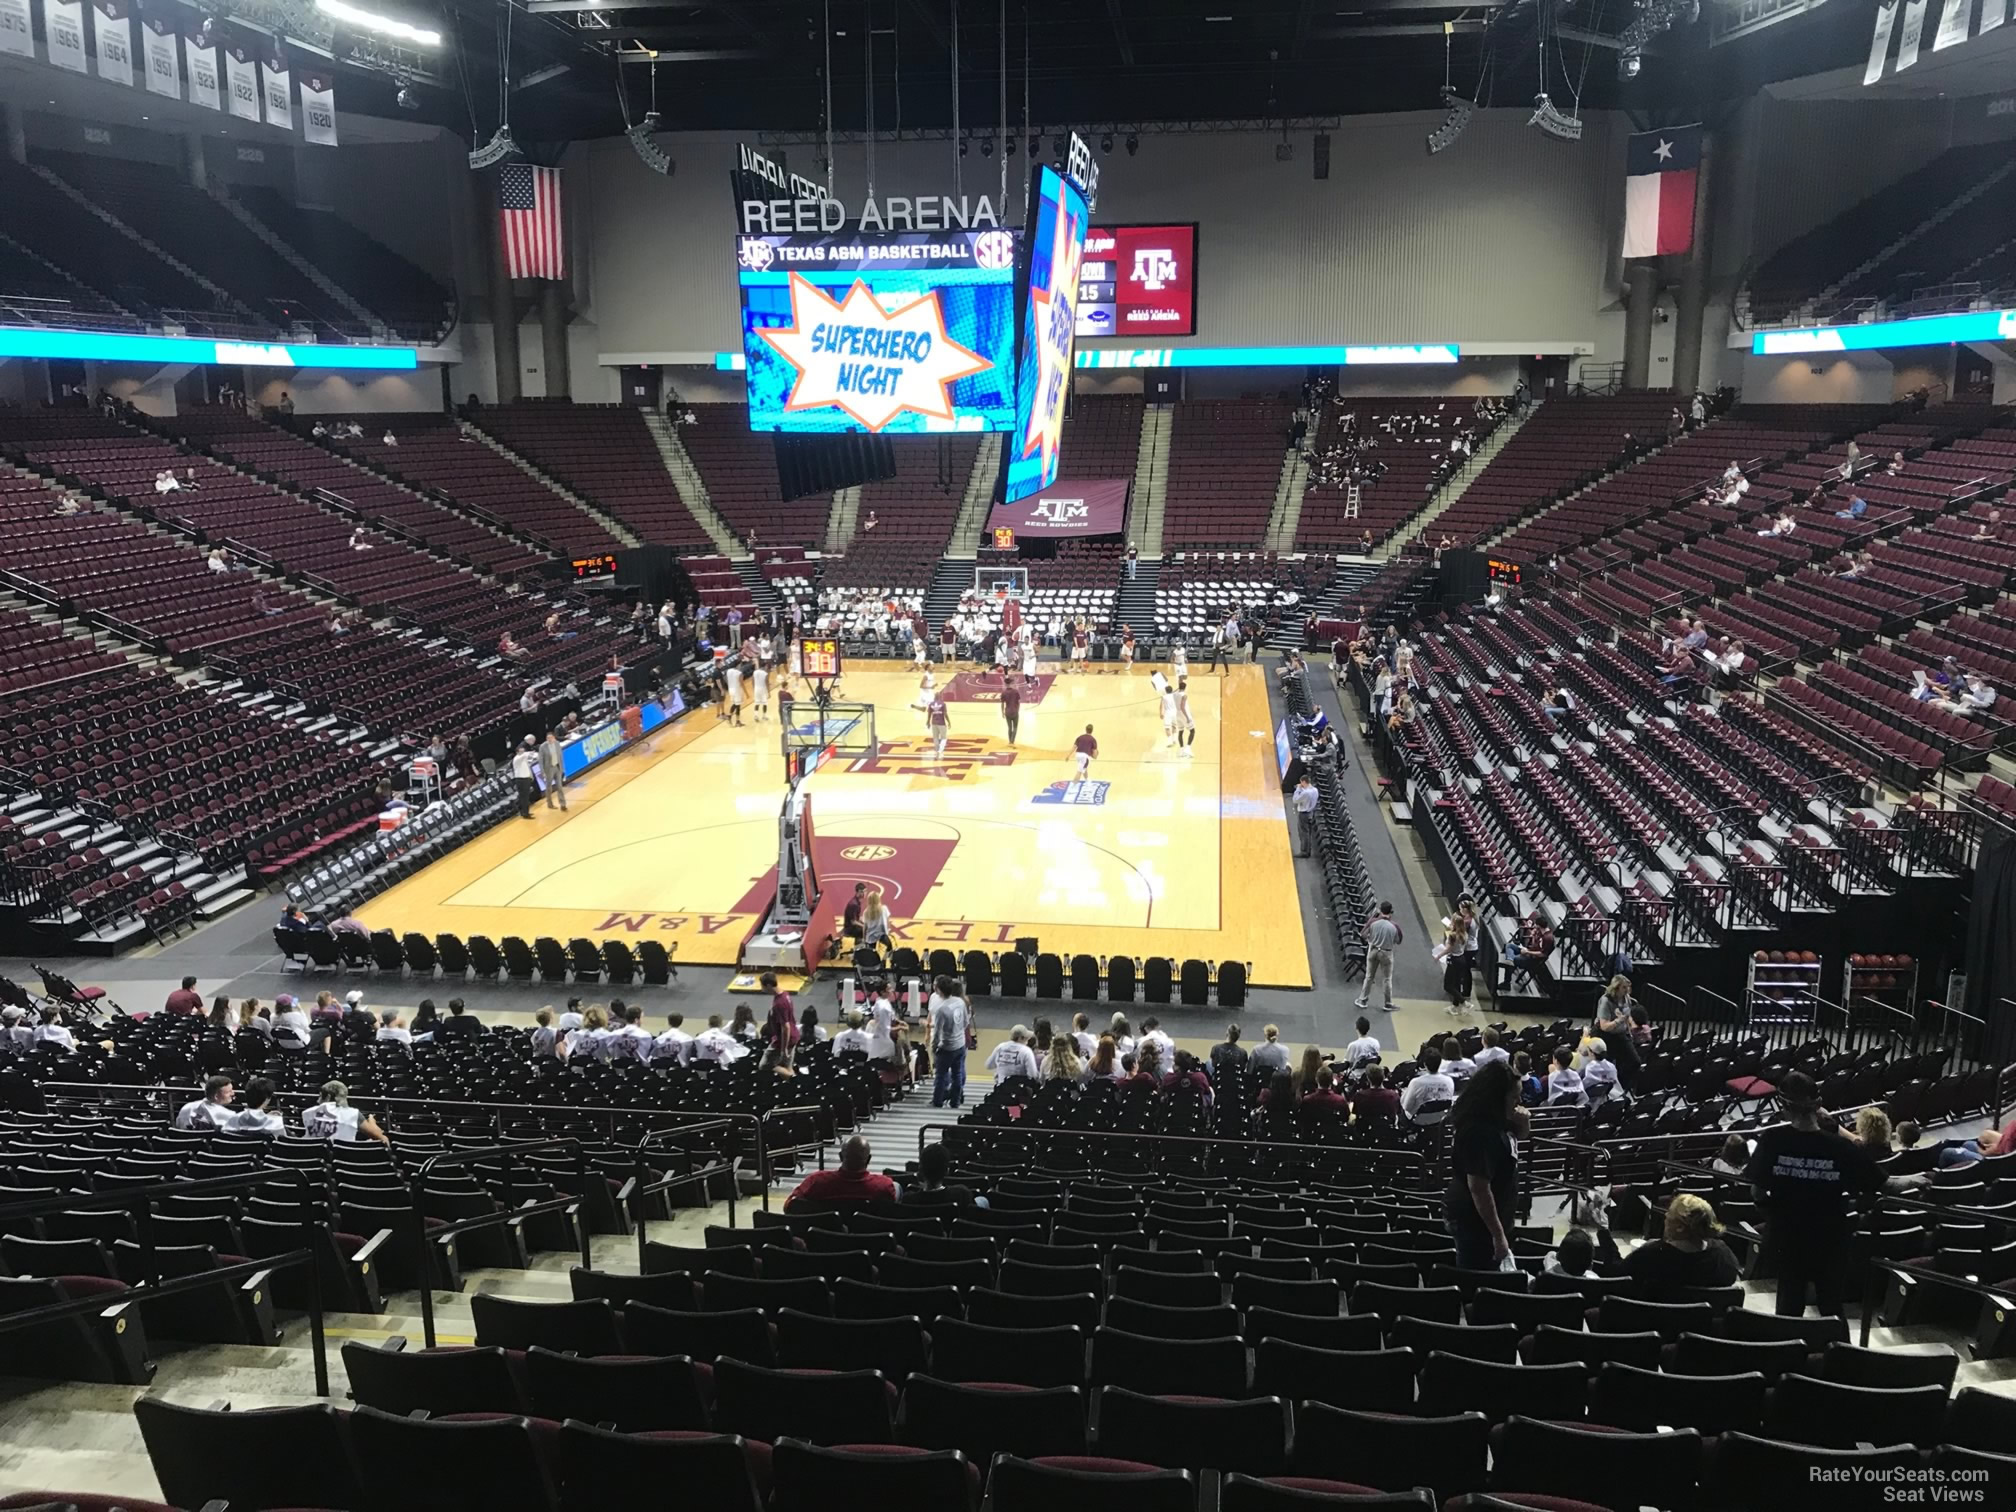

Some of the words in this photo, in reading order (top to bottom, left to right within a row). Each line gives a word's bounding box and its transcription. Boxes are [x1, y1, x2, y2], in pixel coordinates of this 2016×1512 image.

[52, 26, 80, 50] 1969
[102, 41, 128, 64] 1964
[152, 56, 173, 78] 1951
[233, 81, 253, 102] 1922
[269, 92, 287, 111] 1921
[308, 111, 332, 129] 1920
[743, 199, 846, 232] REED
[858, 195, 999, 230] ARENA
[777, 246, 826, 262] TEXAS
[828, 246, 864, 260] A&M
[868, 243, 969, 259] BASKETBALL
[975, 232, 1013, 268] SEC
[811, 323, 932, 364] SUPERHERO
[836, 362, 904, 396] NIGHT
[593, 913, 744, 934] A&M
